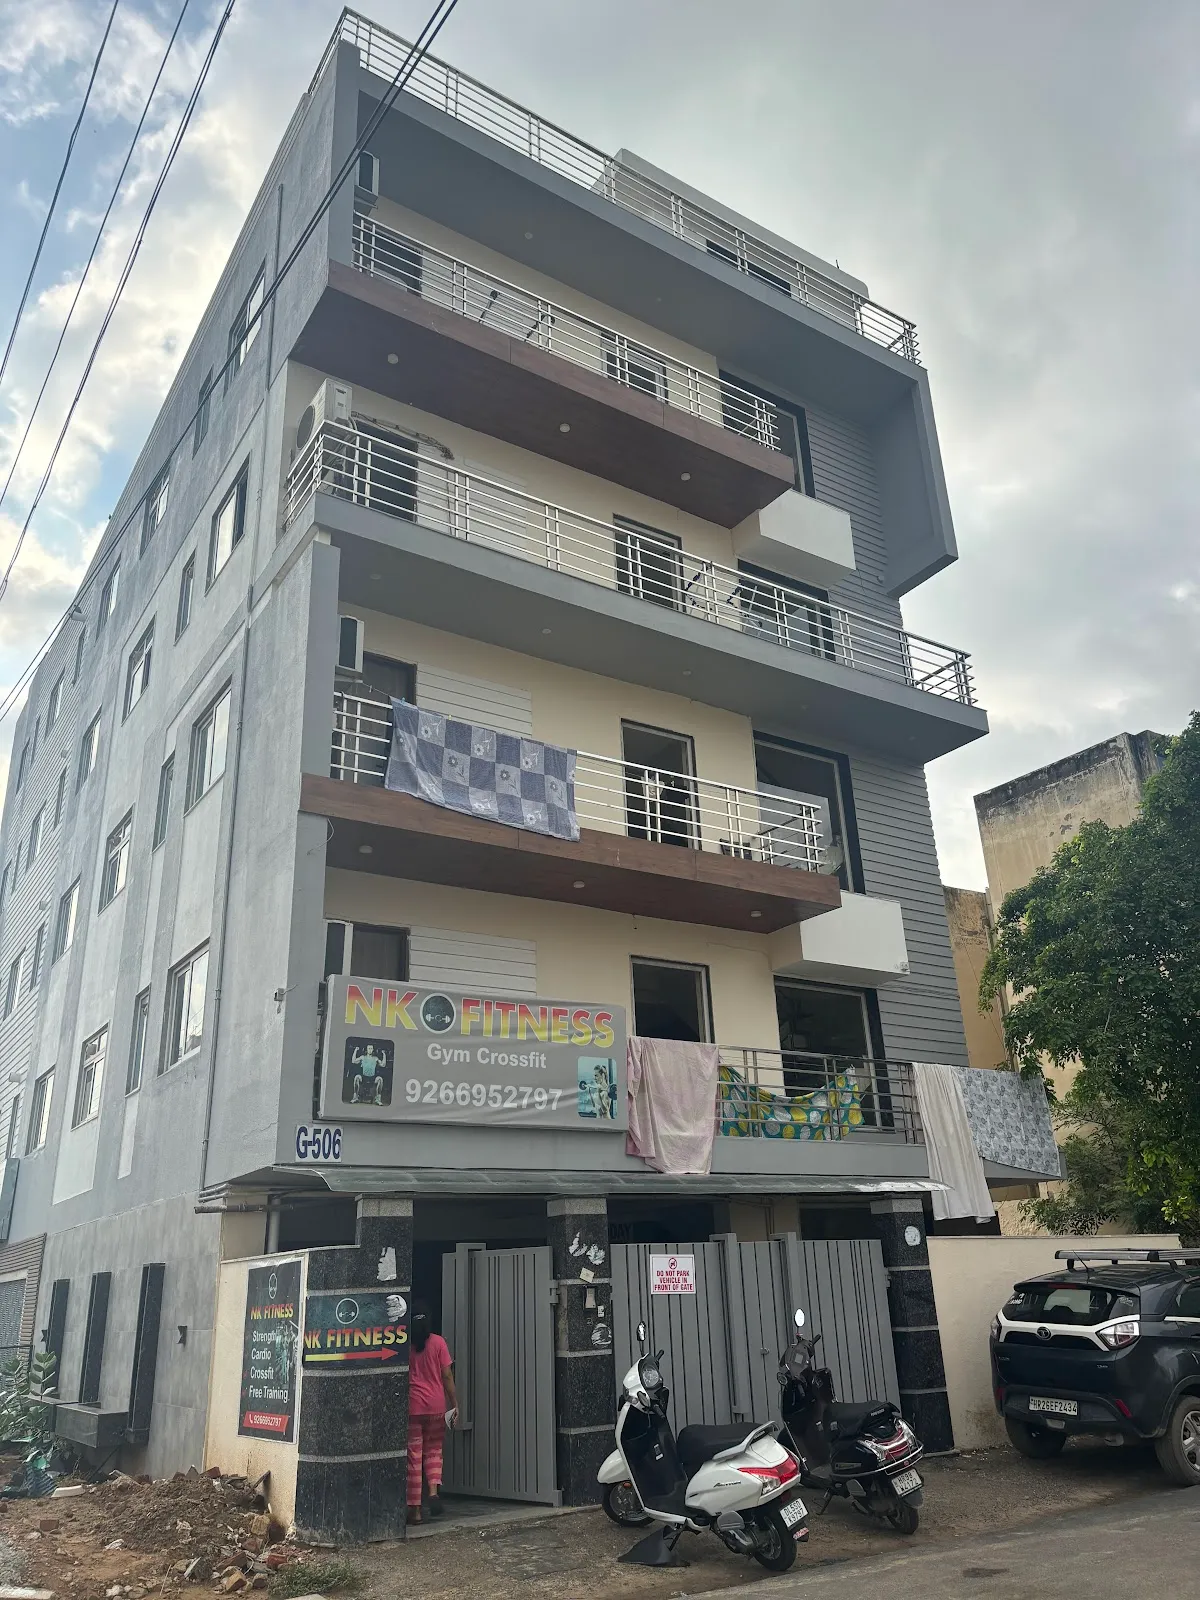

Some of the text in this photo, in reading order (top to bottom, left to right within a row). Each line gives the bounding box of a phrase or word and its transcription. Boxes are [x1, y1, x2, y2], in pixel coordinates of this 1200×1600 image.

[345, 984, 615, 1049] NK FITNESS
[427, 1043, 547, 1069] Gym Crossfit
[405, 1079, 563, 1111] 9266952797
[295, 1126, 342, 1160] G-506
[680, 1283, 693, 1291] GATE
[250, 1303, 294, 1320] NK FITNESS
[304, 1324, 408, 1349] NK FITNESS
[251, 1348, 272, 1360] Cardio
[250, 1366, 274, 1379] Crossfit
[249, 1385, 288, 1403] Free Training
[1033, 1399, 1077, 1413] HR26EF2434
